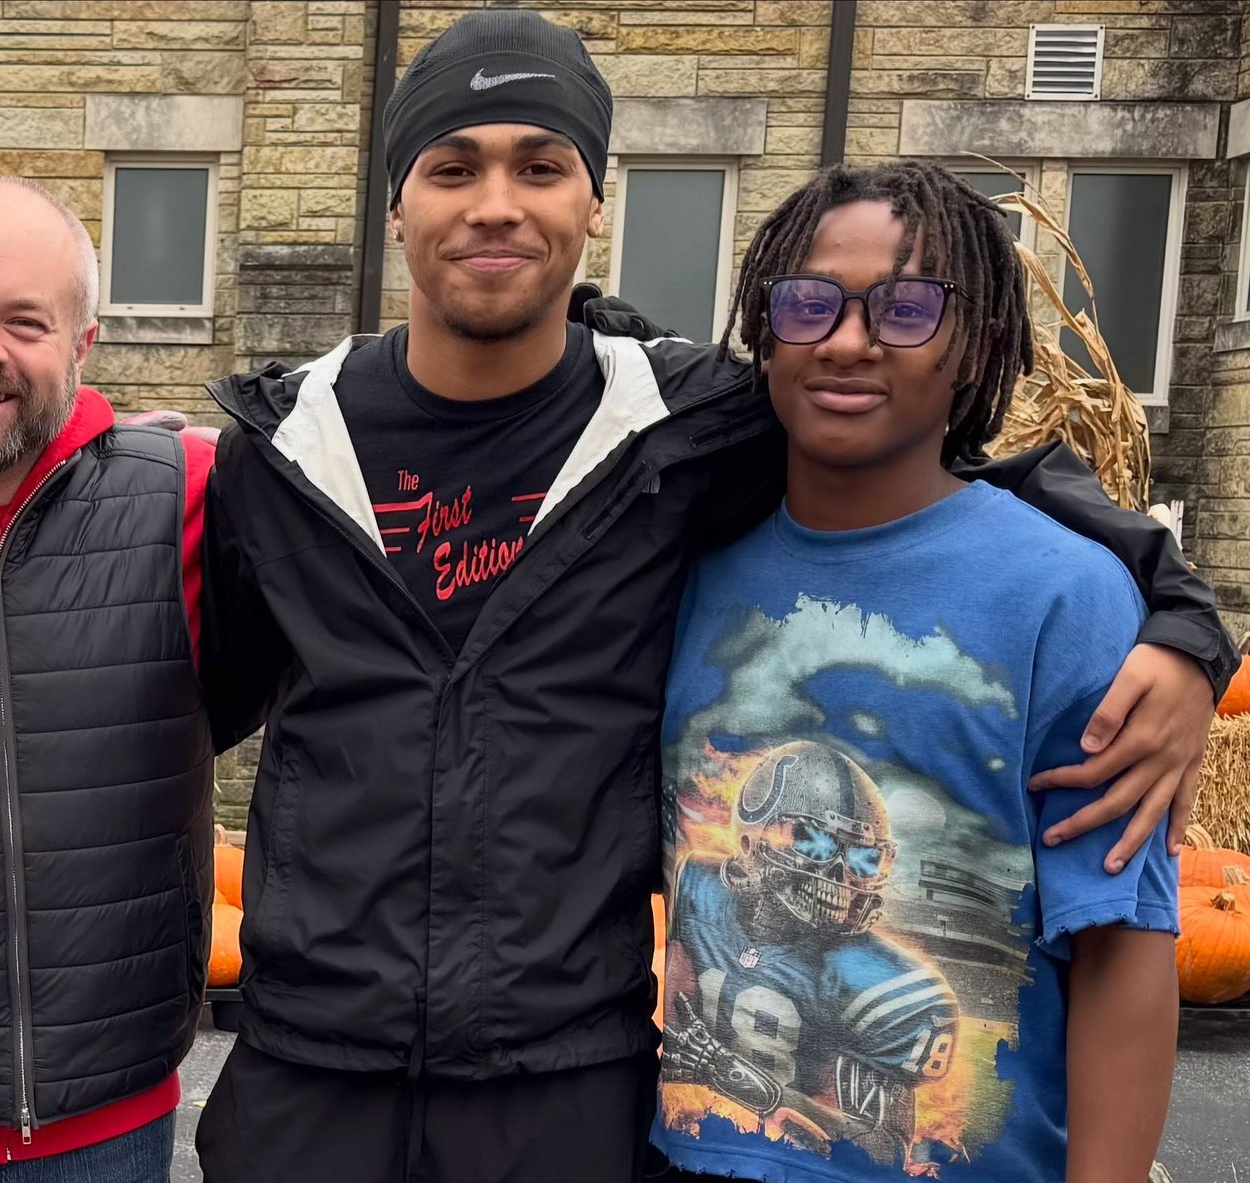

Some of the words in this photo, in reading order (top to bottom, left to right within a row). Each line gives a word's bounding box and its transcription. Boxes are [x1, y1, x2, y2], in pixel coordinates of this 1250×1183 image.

[397, 469, 420, 491] The
[410, 484, 473, 554] First
[900, 1029, 954, 1079] 18
